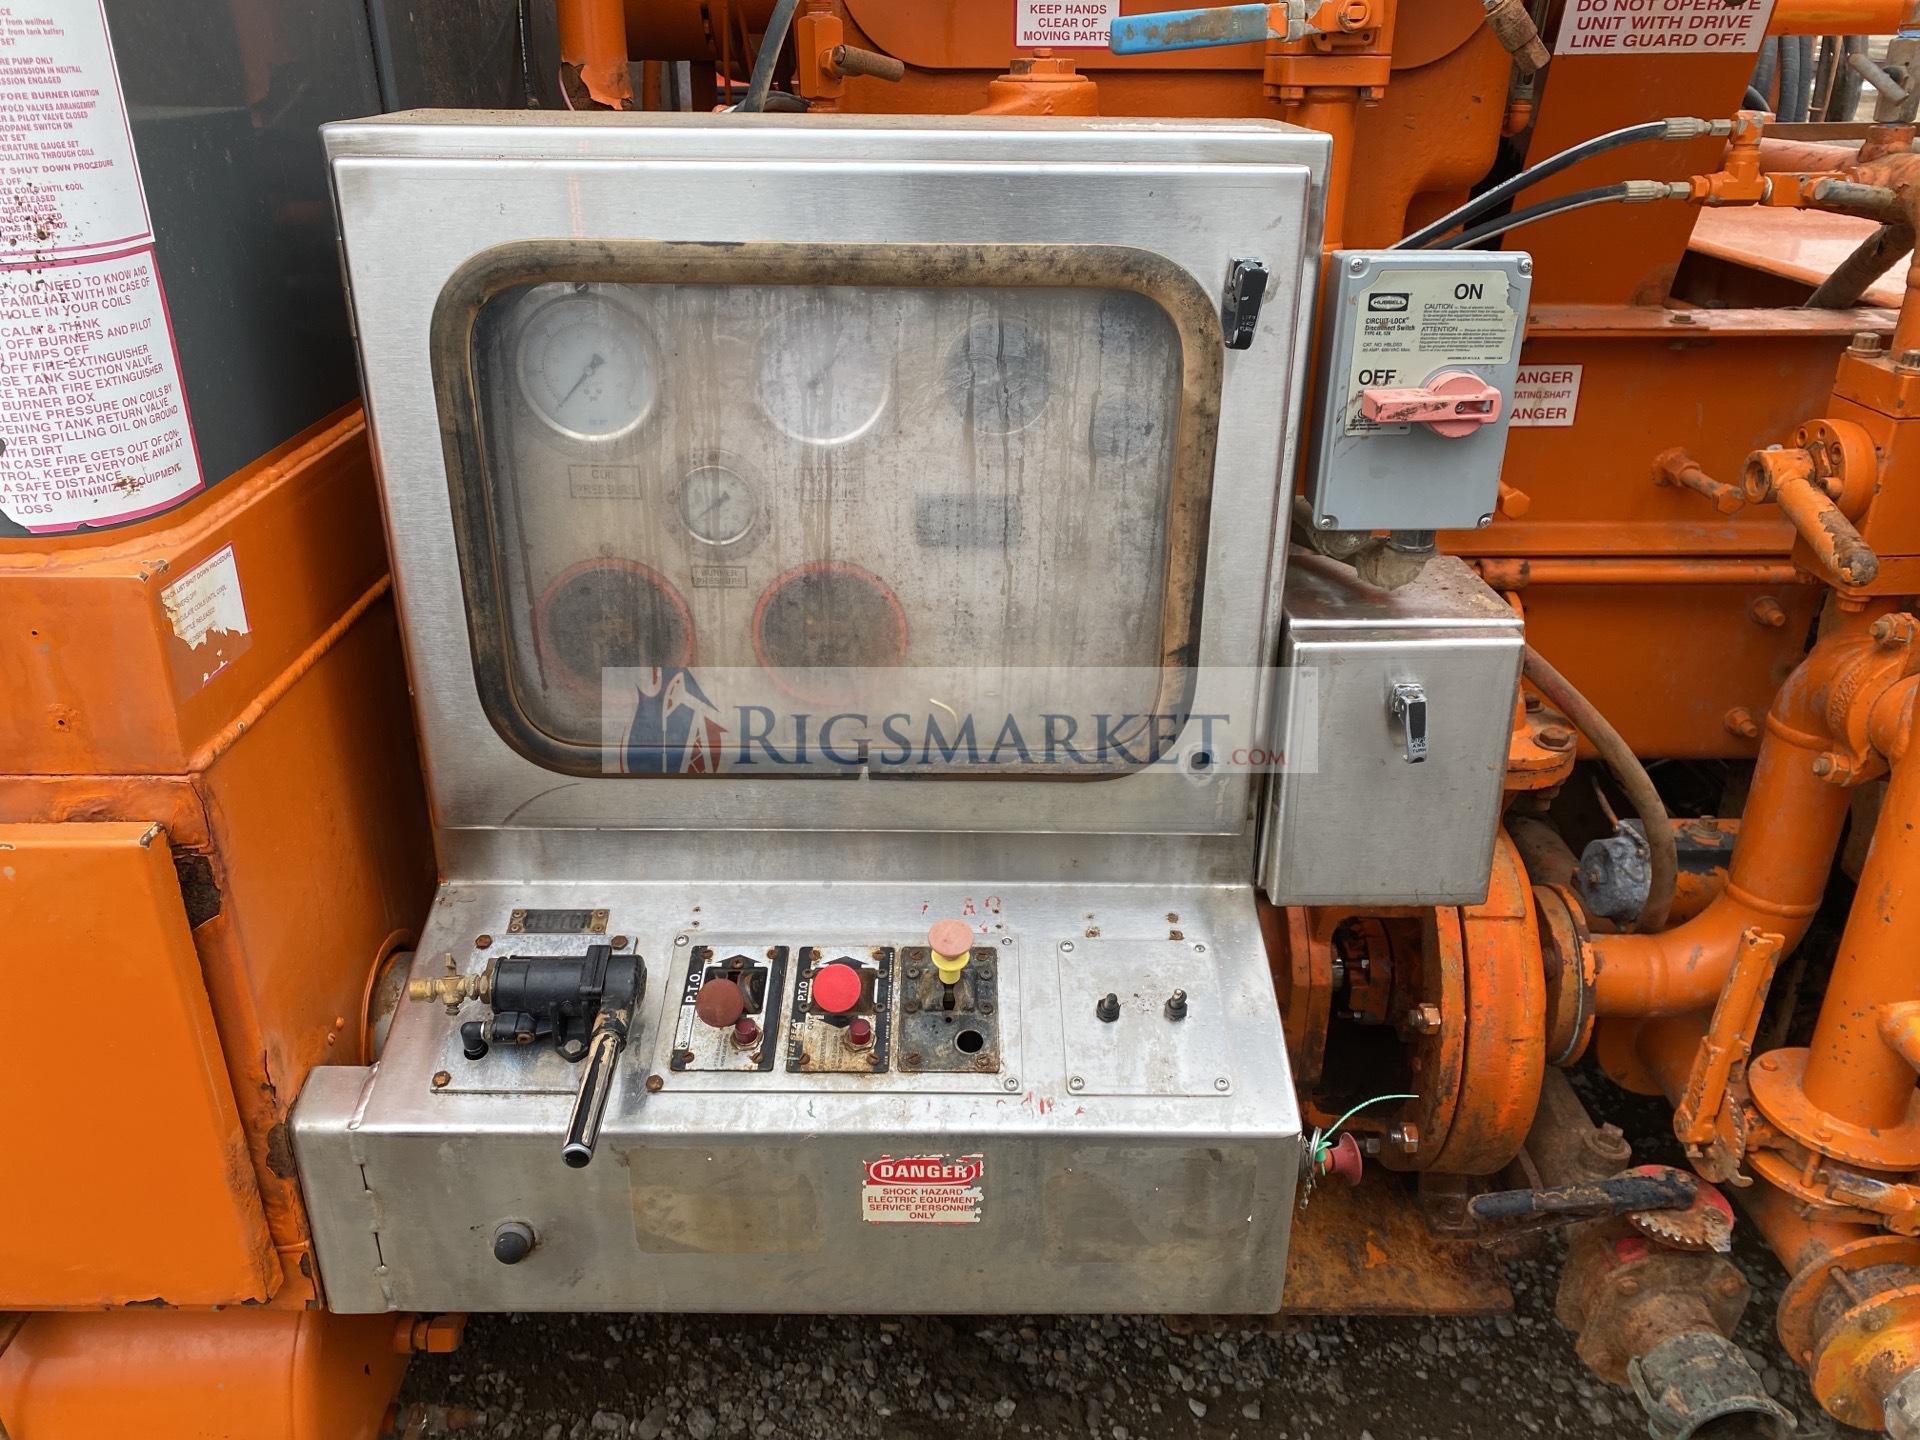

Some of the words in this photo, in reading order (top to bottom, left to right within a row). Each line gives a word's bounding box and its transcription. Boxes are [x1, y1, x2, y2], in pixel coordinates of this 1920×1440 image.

[1030, 5, 1062, 14] KEEP
[1065, 4, 1107, 14] HANDS
[1577, 0, 1610, 11] DO
[1613, 0, 1656, 11] NOT
[1038, 18, 1078, 27] CLEAR
[1082, 18, 1098, 27] OF
[1577, 16, 1625, 30] UNIT
[1632, 16, 1682, 29] WITH
[1689, 15, 1753, 29] DRIVE
[1024, 31, 1070, 40] MOVING
[1074, 31, 1111, 40] PARTS
[1570, 35, 1617, 47] LINE
[1622, 33, 1698, 47] GUARD
[1703, 33, 1746, 46] OFF.
[12, 57, 33, 65] PUMP
[36, 56, 54, 64] ONLY
[28, 76, 61, 84] ENGAGED
[31, 91, 69, 99] BURNER
[71, 89, 99, 97] IGNITION
[27, 103, 54, 111] VALVES
[56, 101, 96, 110] ARRANGEMENT
[66, 111, 88, 119] CLOSED
[34, 123, 62, 131] SWITCH
[68, 140, 79, 148] SET
[42, 150, 76, 158] THROUGH
[78, 148, 94, 156] COILS
[10, 165, 38, 174] SHUT
[43, 164, 71, 172] DOWN
[73, 159, 114, 170] PROCEDURE
[6, 177, 22, 185] OFF
[42, 184, 63, 193] UNTIL
[44, 278, 81, 292] NEED
[84, 275, 101, 287] TO
[103, 270, 132, 282] KNOW
[133, 265, 148, 277] AND
[72, 286, 105, 301] WITH
[107, 284, 118, 295] IN
[119, 281, 141, 294] CASE
[142, 277, 151, 288] OF
[1454, 283, 1484, 300] ON
[1, 308, 41, 320] HOLE
[45, 307, 59, 316] IN
[62, 301, 99, 316] YOUR
[101, 295, 132, 309] COILS
[1, 325, 43, 337] CALM
[47, 324, 56, 334] &
[6, 338, 34, 350] OFF
[38, 329, 104, 347] BURNERS
[107, 325, 129, 338] AND
[130, 317, 152, 333] PILOT
[9, 349, 60, 362] PUMPS
[63, 345, 90, 357] OFF
[33, 360, 65, 373] FIRE
[69, 344, 149, 369] EXTINGUISHER
[24, 372, 66, 386] TANK
[67, 363, 123, 380] SUCTION
[124, 354, 154, 370] VALVE
[18, 385, 58, 398] REAR
[62, 380, 93, 394] FIRE
[95, 363, 164, 389] EXTINGUISHER
[1358, 369, 1397, 386] OFF
[46, 399, 120, 420] PRESSURE
[121, 395, 138, 408] ON
[139, 387, 164, 402] COILS
[164, 383, 173, 394] BY
[1543, 390, 1572, 399] SHAFT
[2, 397, 62, 412] BURNER
[66, 392, 96, 405] BOX
[55, 417, 93, 431] TANK
[97, 407, 144, 425] RETURN
[144, 397, 170, 412] VALVE
[41, 427, 107, 445] SPILLING
[109, 422, 131, 434] OIL
[132, 416, 148, 429] ON
[149, 404, 179, 423] GROUND
[14, 457, 52, 470] CASE
[56, 453, 88, 466] FIRE
[90, 446, 125, 461] GETS
[128, 440, 150, 454] OUT
[150, 437, 162, 448] OF
[163, 429, 180, 443] CON-
[31, 445, 63, 457] DIRT
[43, 466, 81, 478] KEEP
[85, 452, 150, 473] EVERYONE
[152, 443, 175, 459] AWAY
[175, 438, 183, 450] AT
[3, 483, 12, 493] A
[15, 479, 53, 493] SAFE
[56, 470, 123, 490] DISTANCE
[13, 493, 38, 504] TRY
[43, 491, 62, 502] TO
[15, 504, 53, 516] LOSS
[880, 1164, 968, 1178] DANGER
